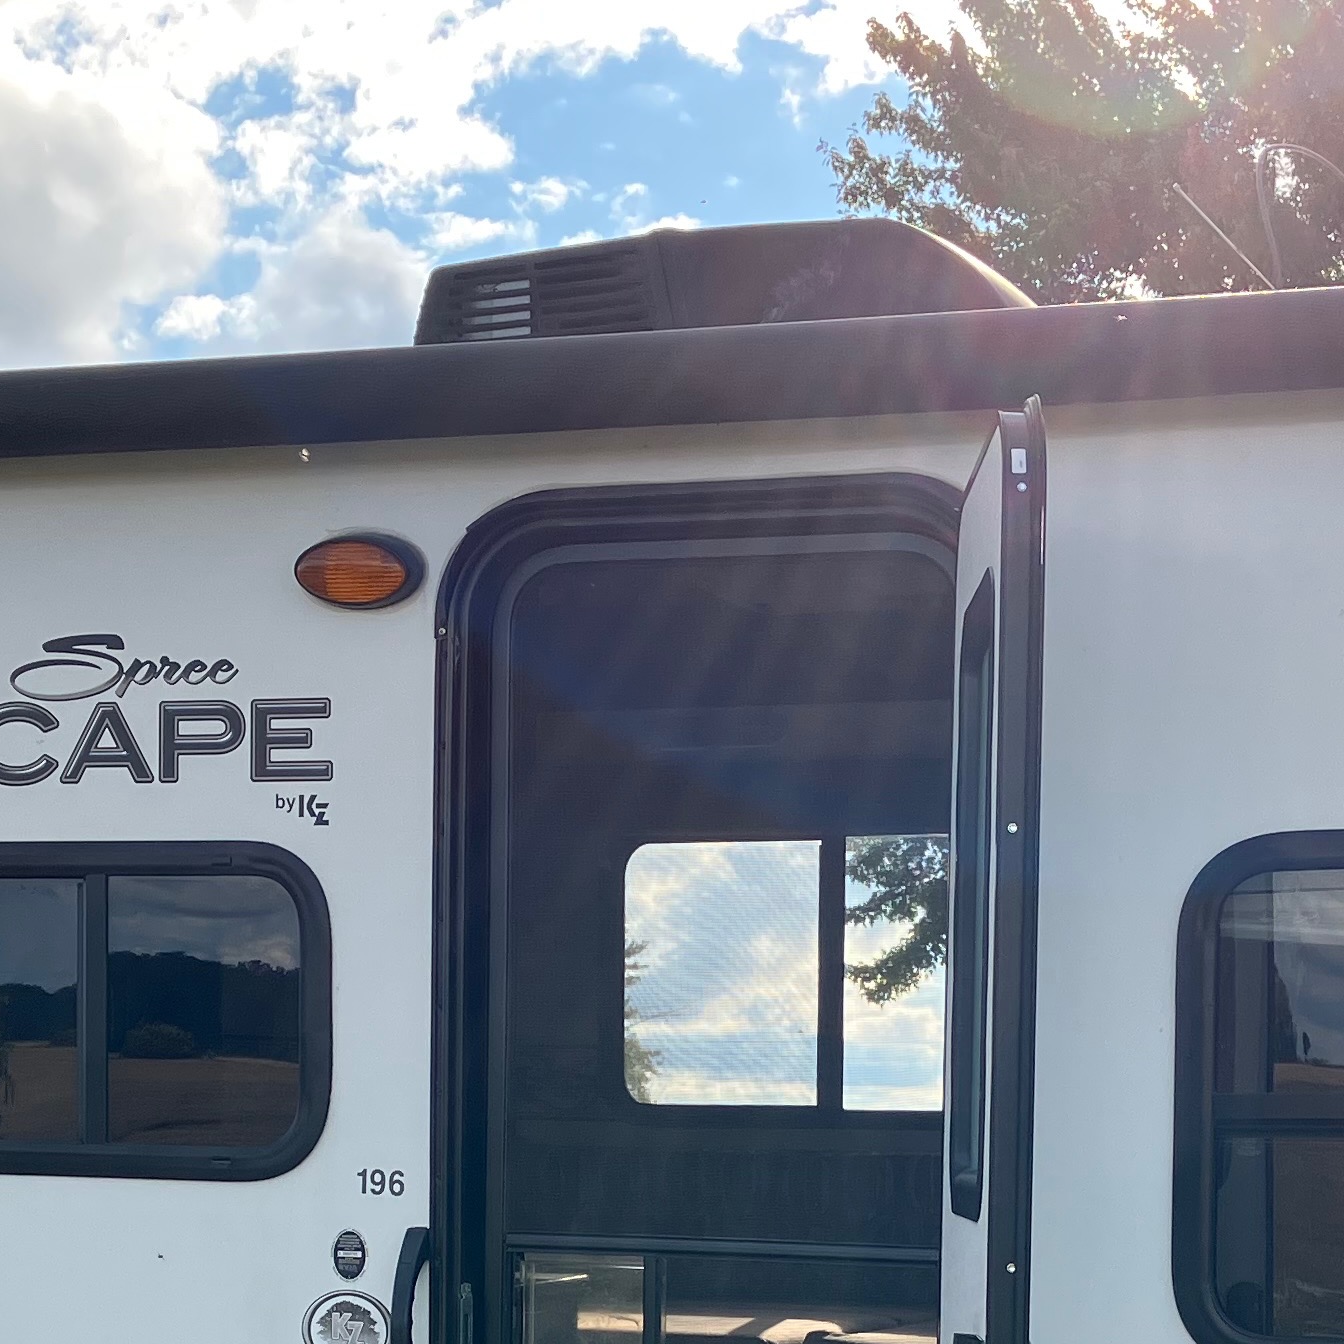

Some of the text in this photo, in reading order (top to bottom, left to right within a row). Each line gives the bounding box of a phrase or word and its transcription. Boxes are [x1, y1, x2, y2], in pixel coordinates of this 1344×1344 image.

[11, 634, 239, 701] Spree
[275, 794, 330, 826] by KZ
[357, 1168, 405, 1197] 196
